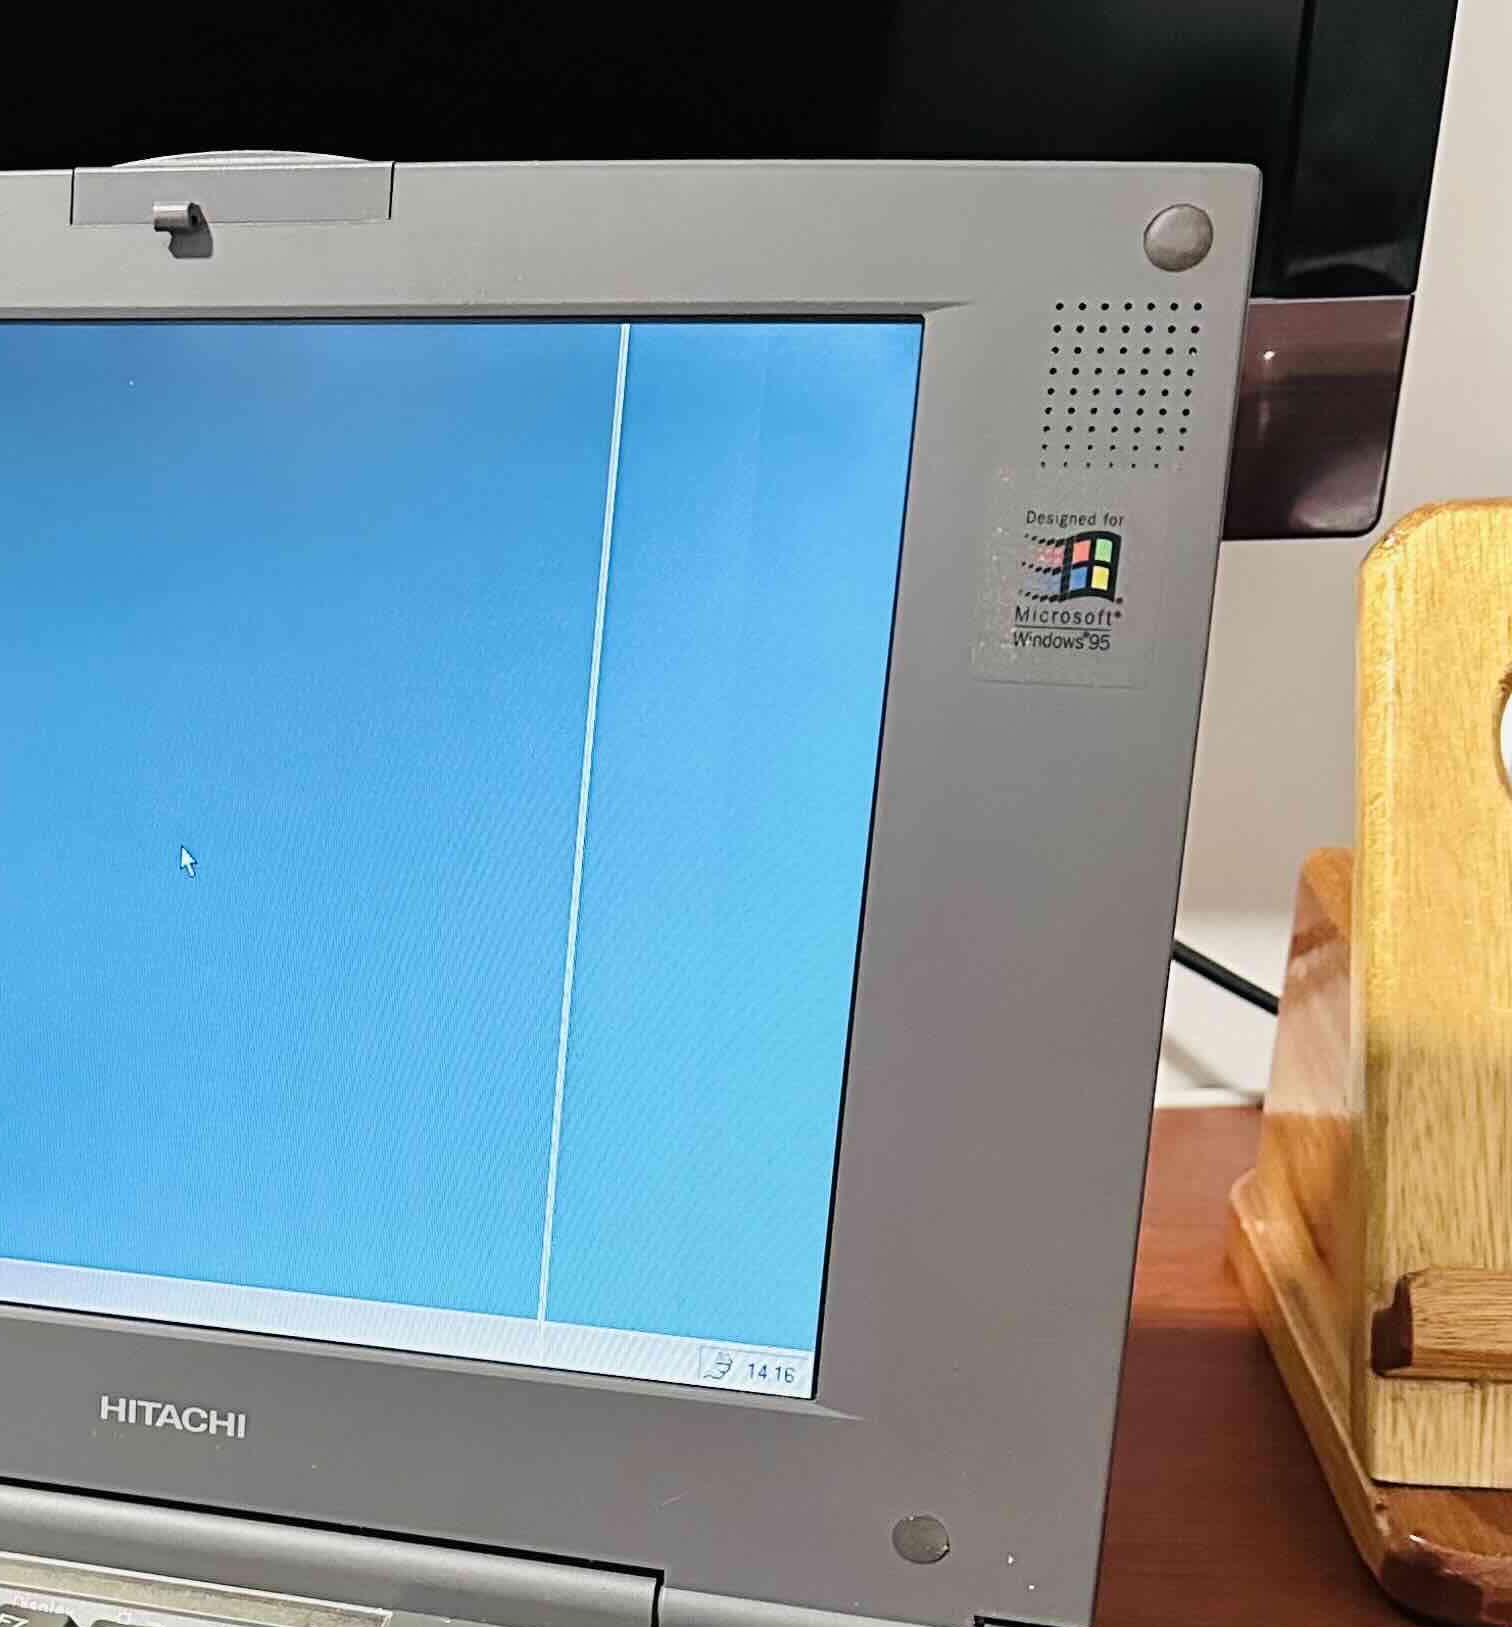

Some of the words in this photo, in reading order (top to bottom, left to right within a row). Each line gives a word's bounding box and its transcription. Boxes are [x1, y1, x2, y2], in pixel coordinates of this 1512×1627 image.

[1025, 510, 1096, 528] Designed
[1102, 512, 1124, 527] for
[1015, 606, 1113, 627] Microsoft
[99, 1394, 247, 1439] HITACHI
